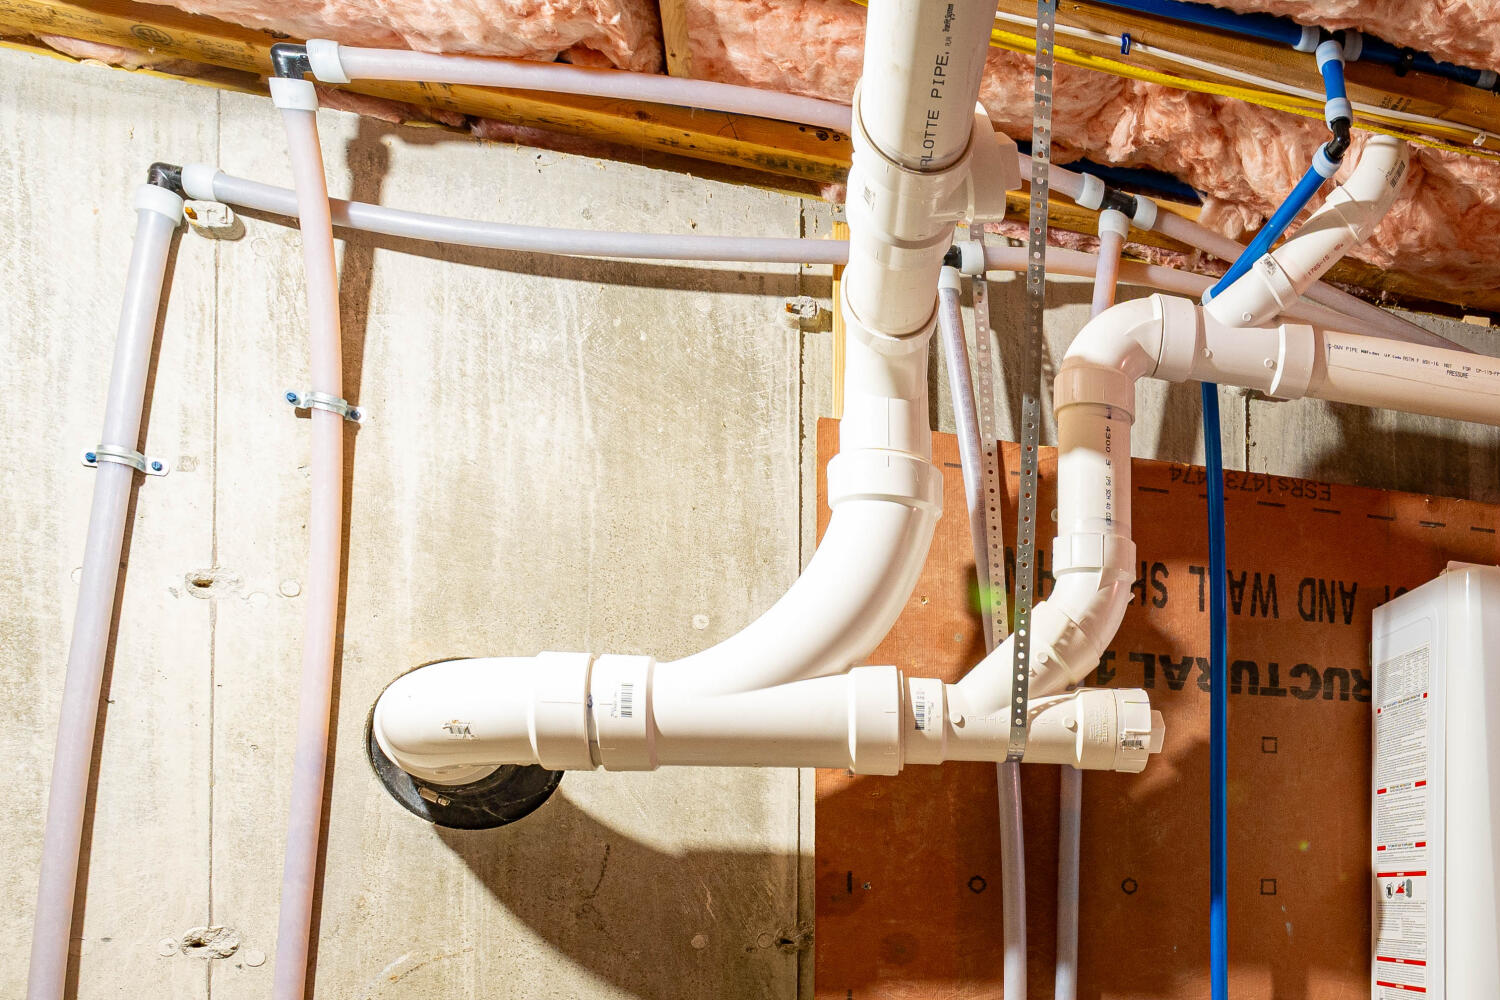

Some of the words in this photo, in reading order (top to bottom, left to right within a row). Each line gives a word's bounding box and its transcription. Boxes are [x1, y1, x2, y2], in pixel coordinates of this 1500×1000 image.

[920, 109, 940, 168] RLOTTE
[1169, 464, 1207, 487] 474
[1189, 564, 1279, 619] WAL
[1298, 576, 1358, 626] AND
[1129, 652, 1371, 702] RUCTURAL
